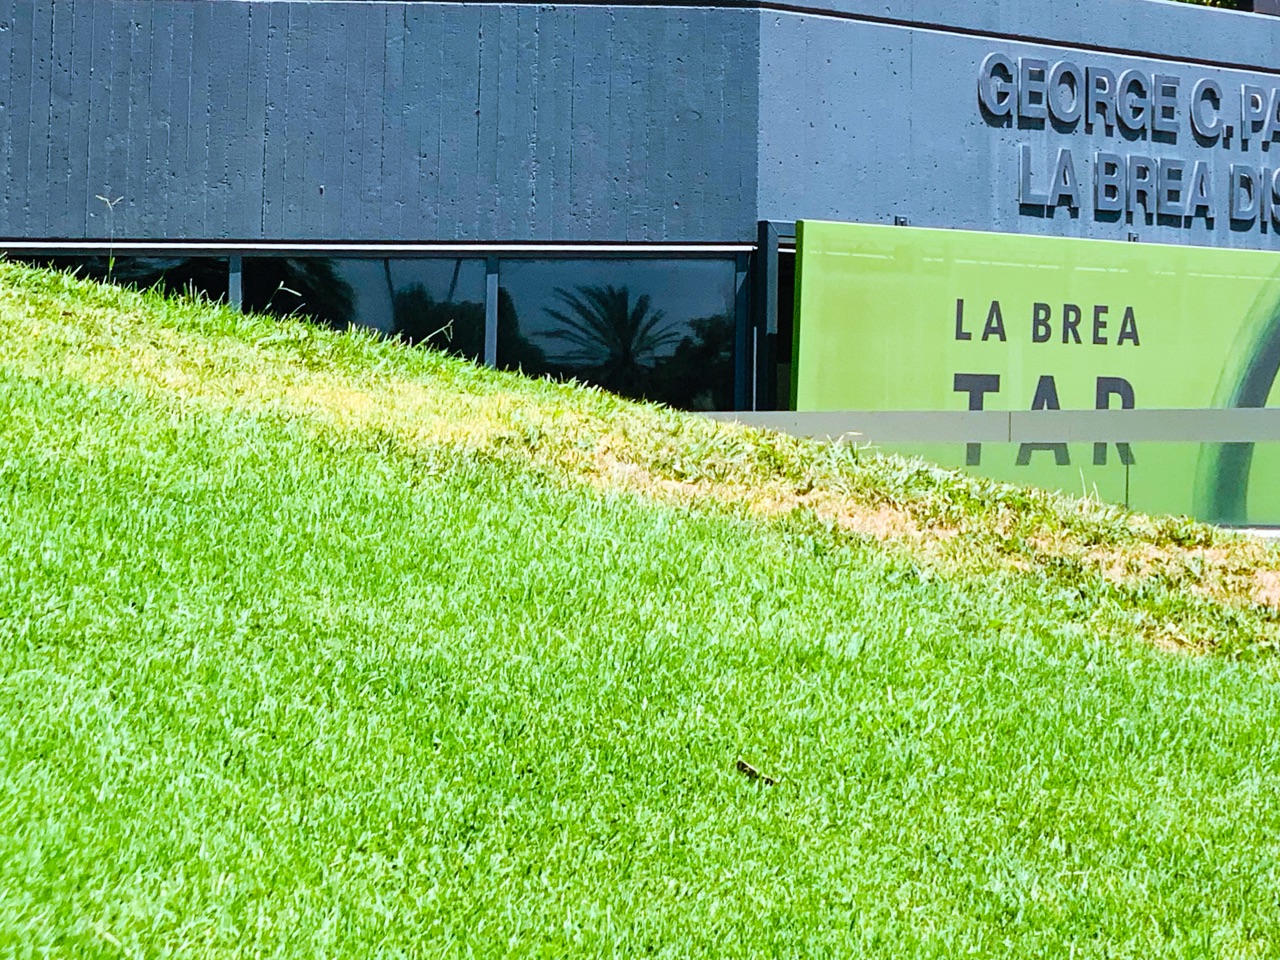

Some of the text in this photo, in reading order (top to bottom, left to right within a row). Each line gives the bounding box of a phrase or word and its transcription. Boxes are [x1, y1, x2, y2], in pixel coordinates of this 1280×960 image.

[978, 52, 1181, 139] GEORGE
[1190, 78, 1234, 146] C.
[1019, 144, 1080, 214] LA
[1094, 151, 1216, 226] BREA
[955, 298, 1140, 346] LA BREA
[953, 373, 1136, 466] TAR
